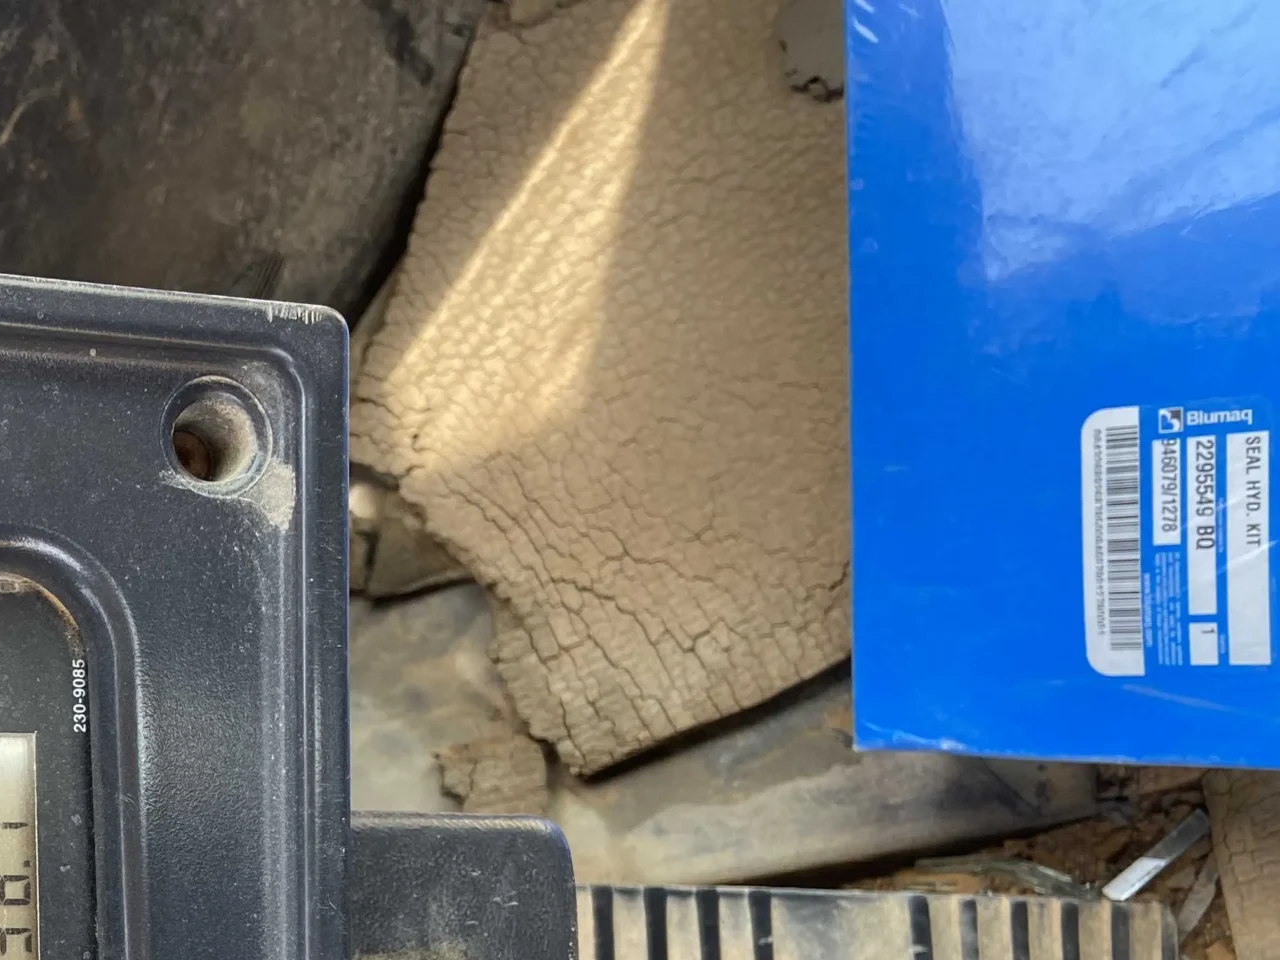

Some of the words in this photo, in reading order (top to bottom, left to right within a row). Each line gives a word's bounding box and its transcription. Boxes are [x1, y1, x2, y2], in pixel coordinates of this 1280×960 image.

[1187, 409, 1253, 426] Blumaq
[1245, 436, 1261, 475] SEAL
[1161, 437, 1178, 533] 946079/1278
[1196, 440, 1215, 517] 2295549
[1245, 480, 1261, 517] HYD.
[1196, 525, 1216, 551] BQ
[1246, 523, 1261, 547] KIT
[1200, 627, 1215, 635] 1
[72, 659, 87, 733] 230-9085
